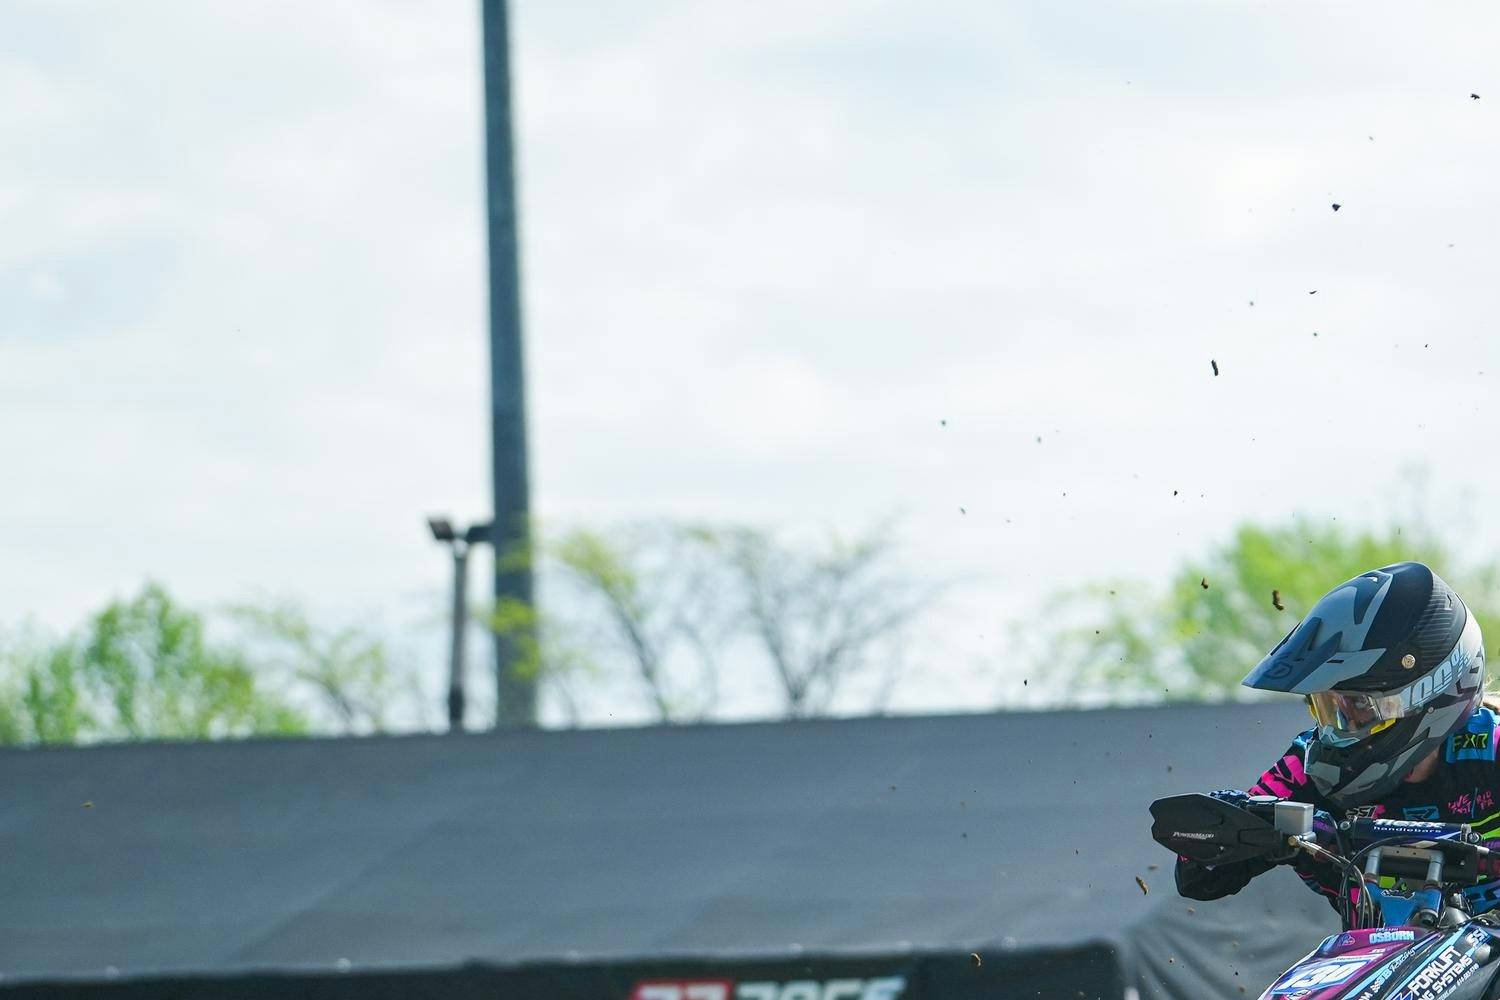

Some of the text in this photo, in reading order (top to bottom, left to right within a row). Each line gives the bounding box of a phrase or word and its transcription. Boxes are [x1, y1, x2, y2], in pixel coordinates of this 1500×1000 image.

[1373, 826, 1442, 834] handlebars
[1369, 930, 1415, 944] OSBORN
[1466, 927, 1491, 948] SSI
[1273, 960, 1369, 993] 130
[1408, 945, 1462, 996] FORKLIFT
[1432, 955, 1473, 994] SYSTEMS
